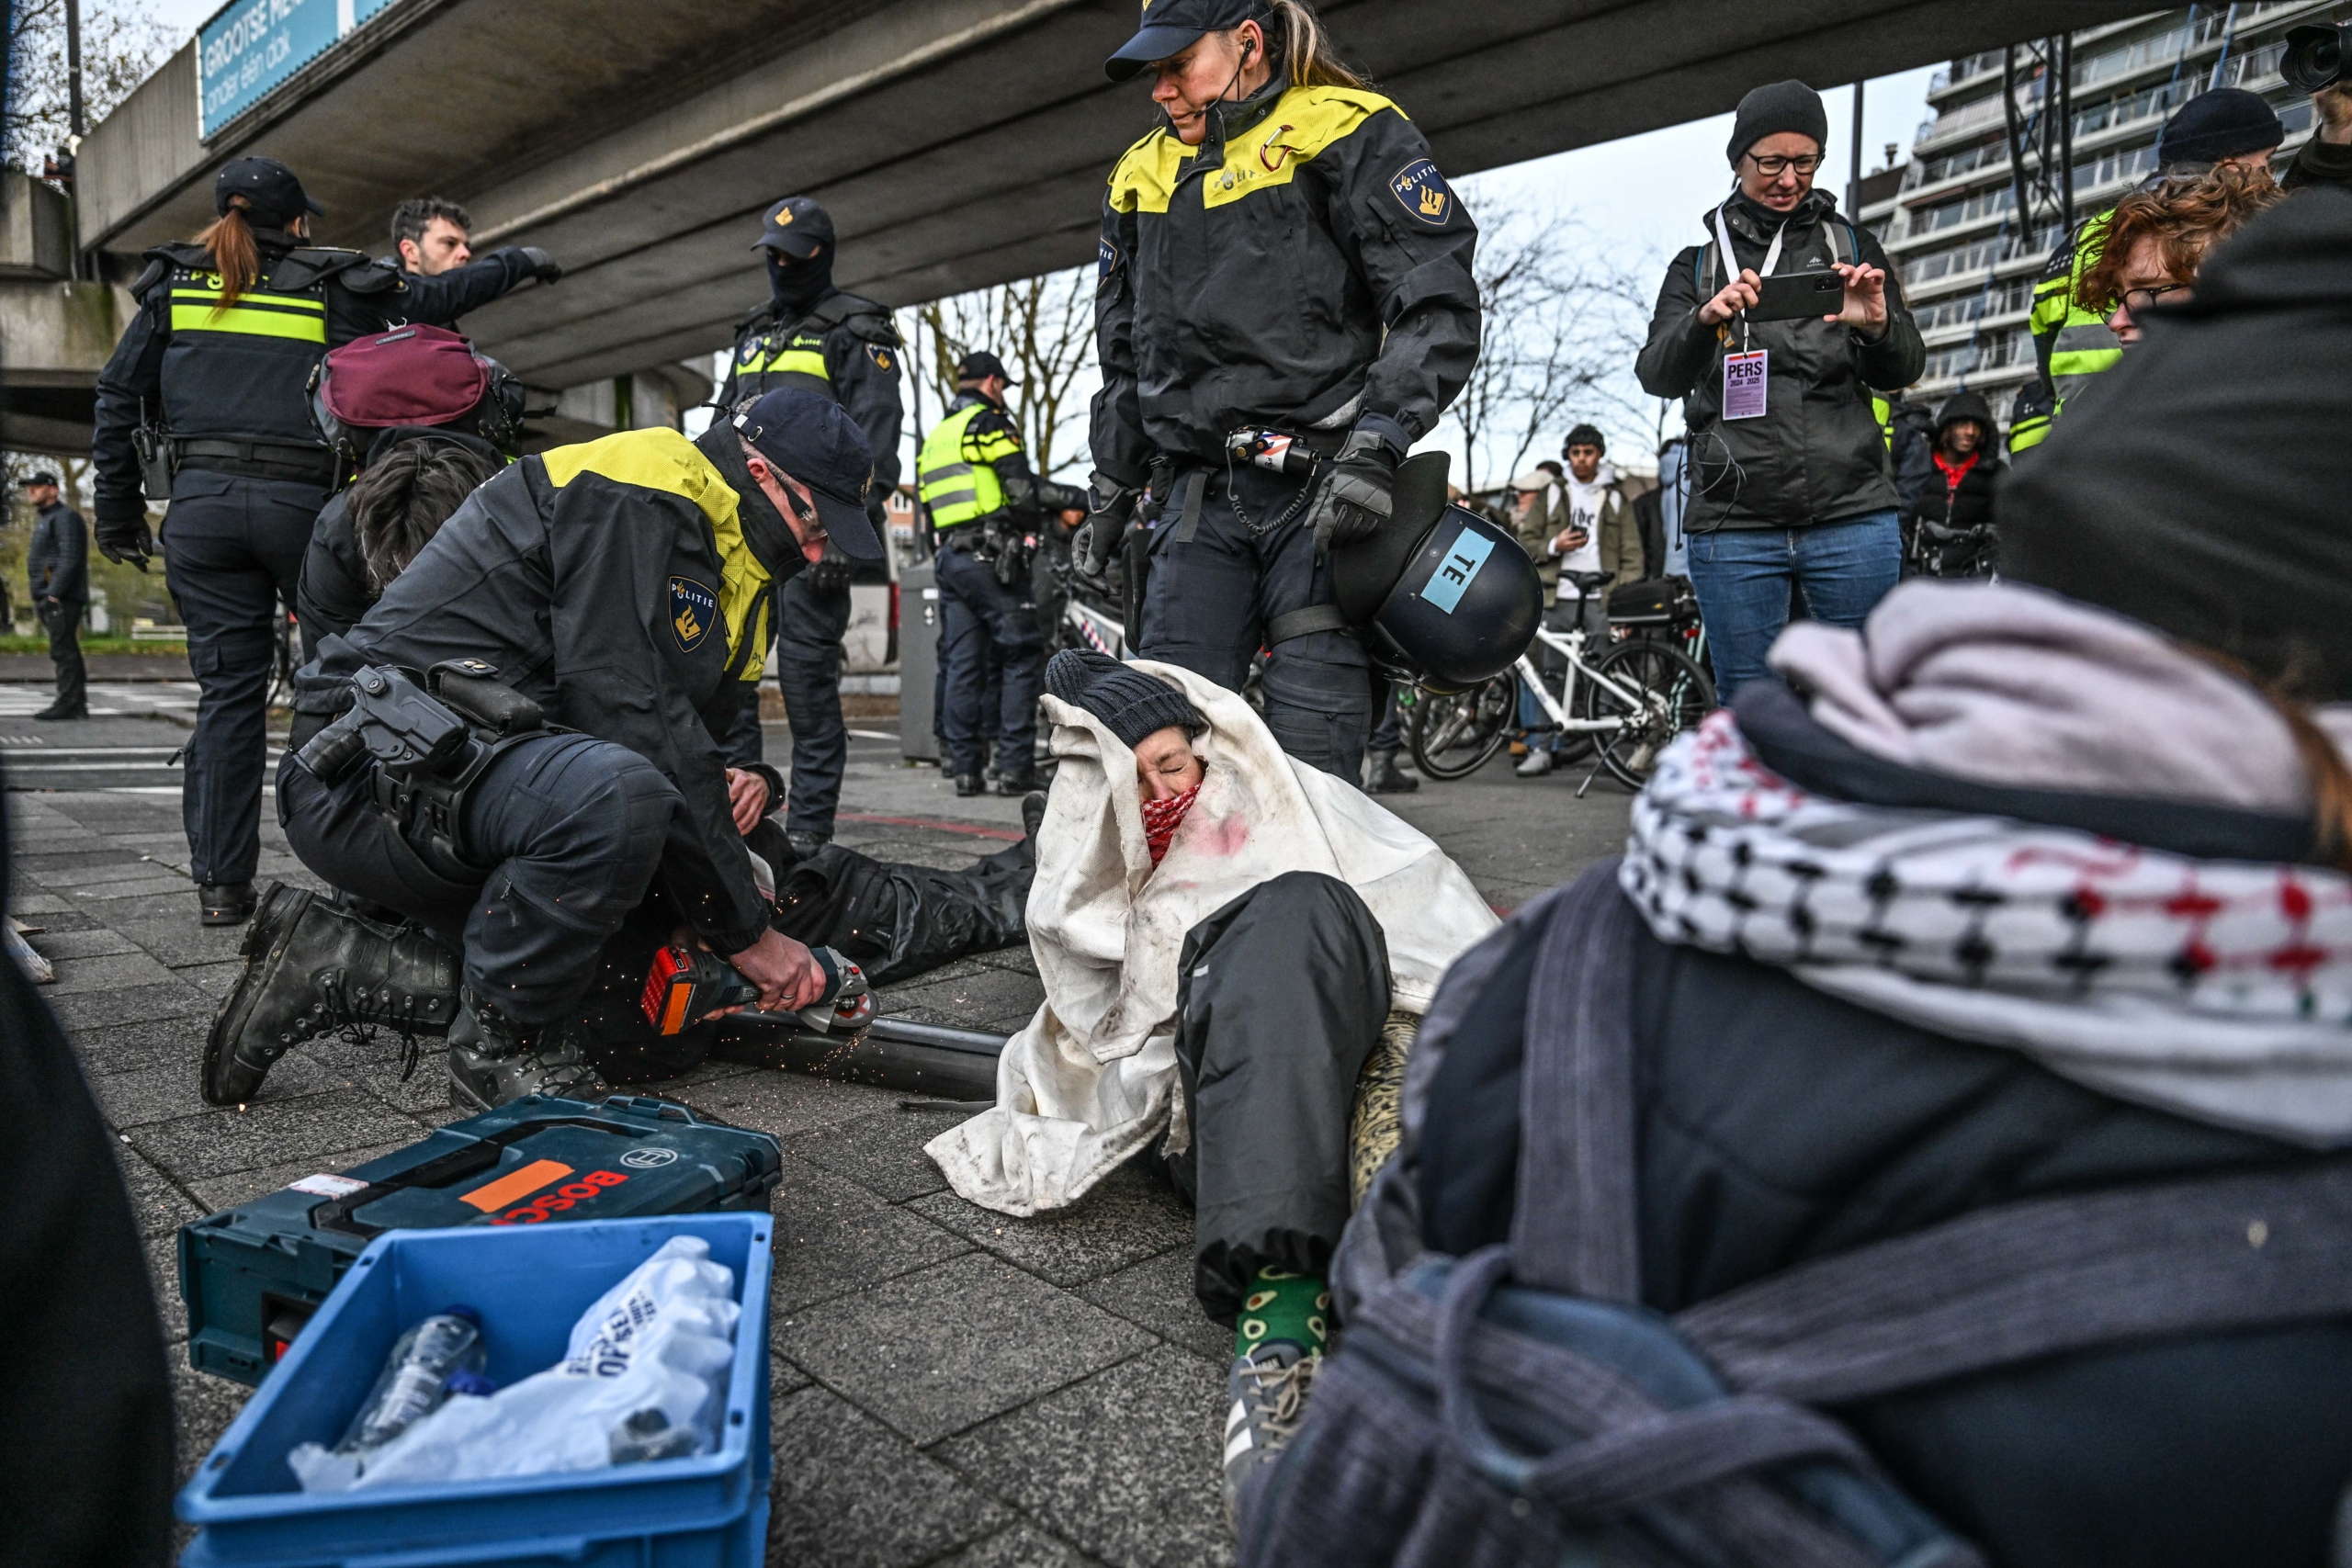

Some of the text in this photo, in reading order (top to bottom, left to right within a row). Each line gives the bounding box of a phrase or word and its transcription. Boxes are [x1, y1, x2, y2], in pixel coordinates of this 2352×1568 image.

[205, 0, 267, 79] GROOTSE
[1728, 361, 1762, 379] PERS
[1730, 377, 1760, 388] 2024 2025
[1442, 554, 1476, 586] TE
[672, 583, 714, 608] POLITIE
[490, 1169, 629, 1226] BOSC
